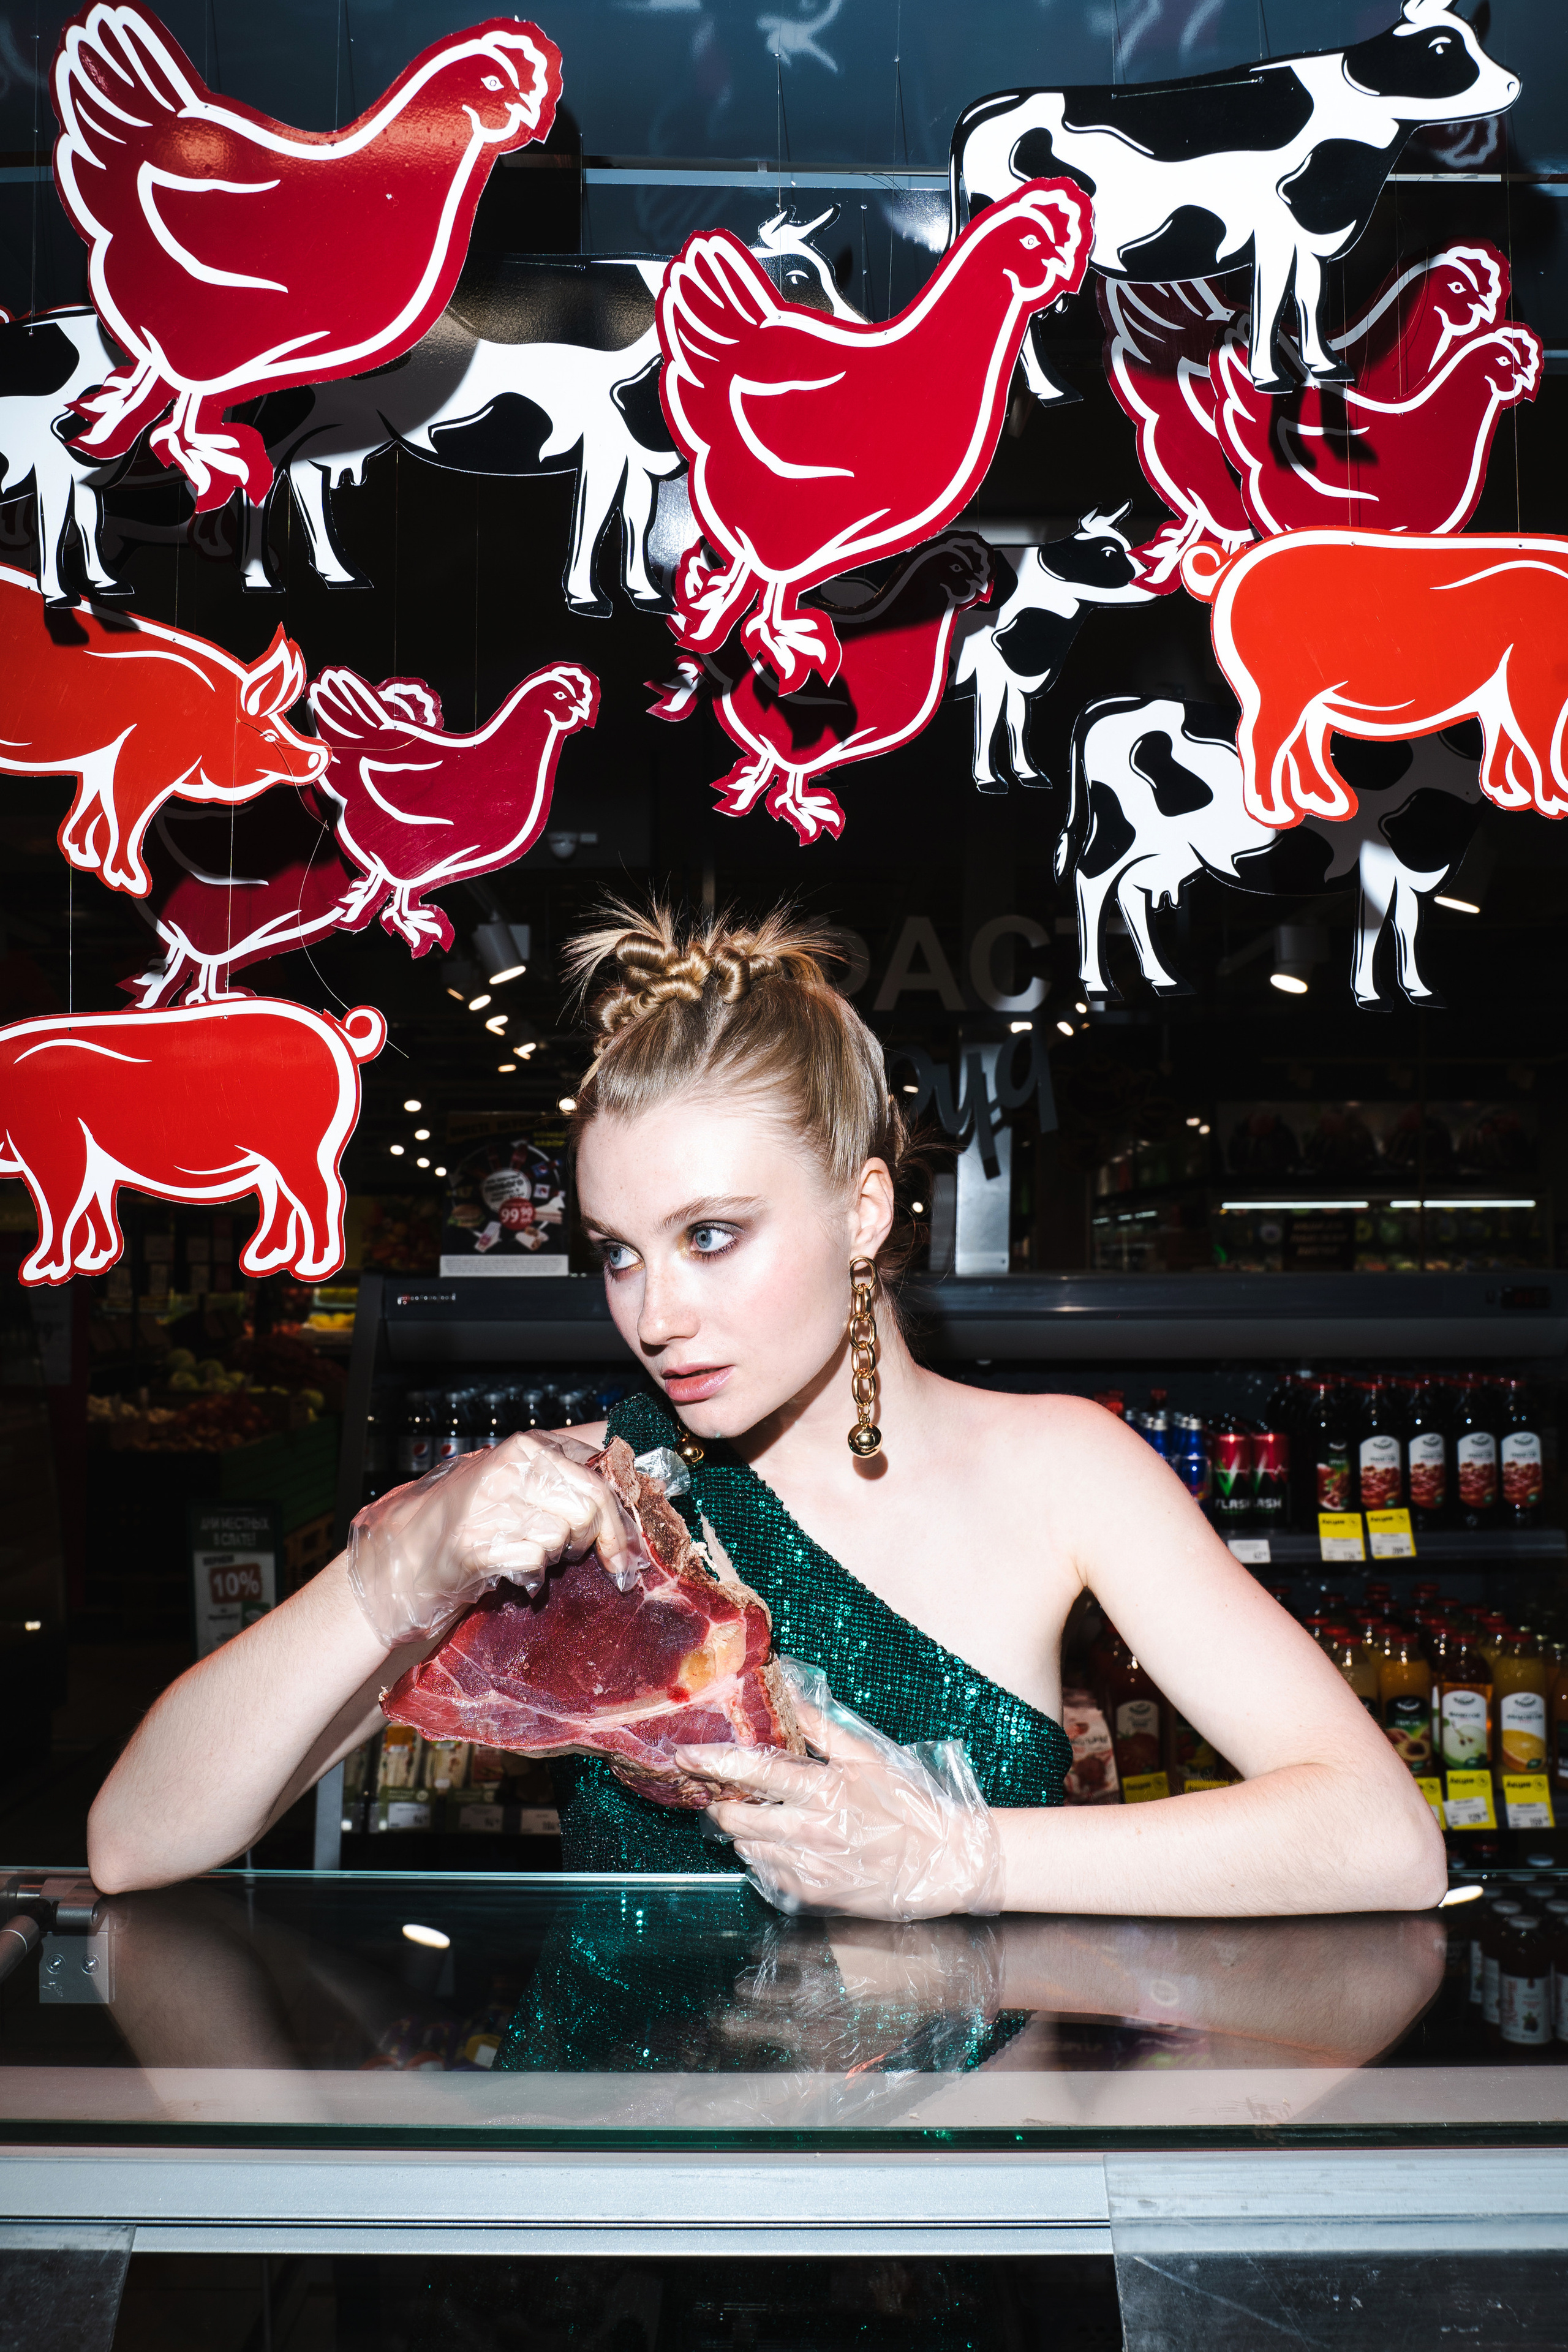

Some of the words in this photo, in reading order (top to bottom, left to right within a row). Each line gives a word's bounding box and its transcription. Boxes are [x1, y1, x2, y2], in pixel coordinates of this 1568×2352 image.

[501, 1208, 519, 1223] 99
[1256, 1497, 1282, 1509] ASH
[213, 1569, 260, 1597] 10%
